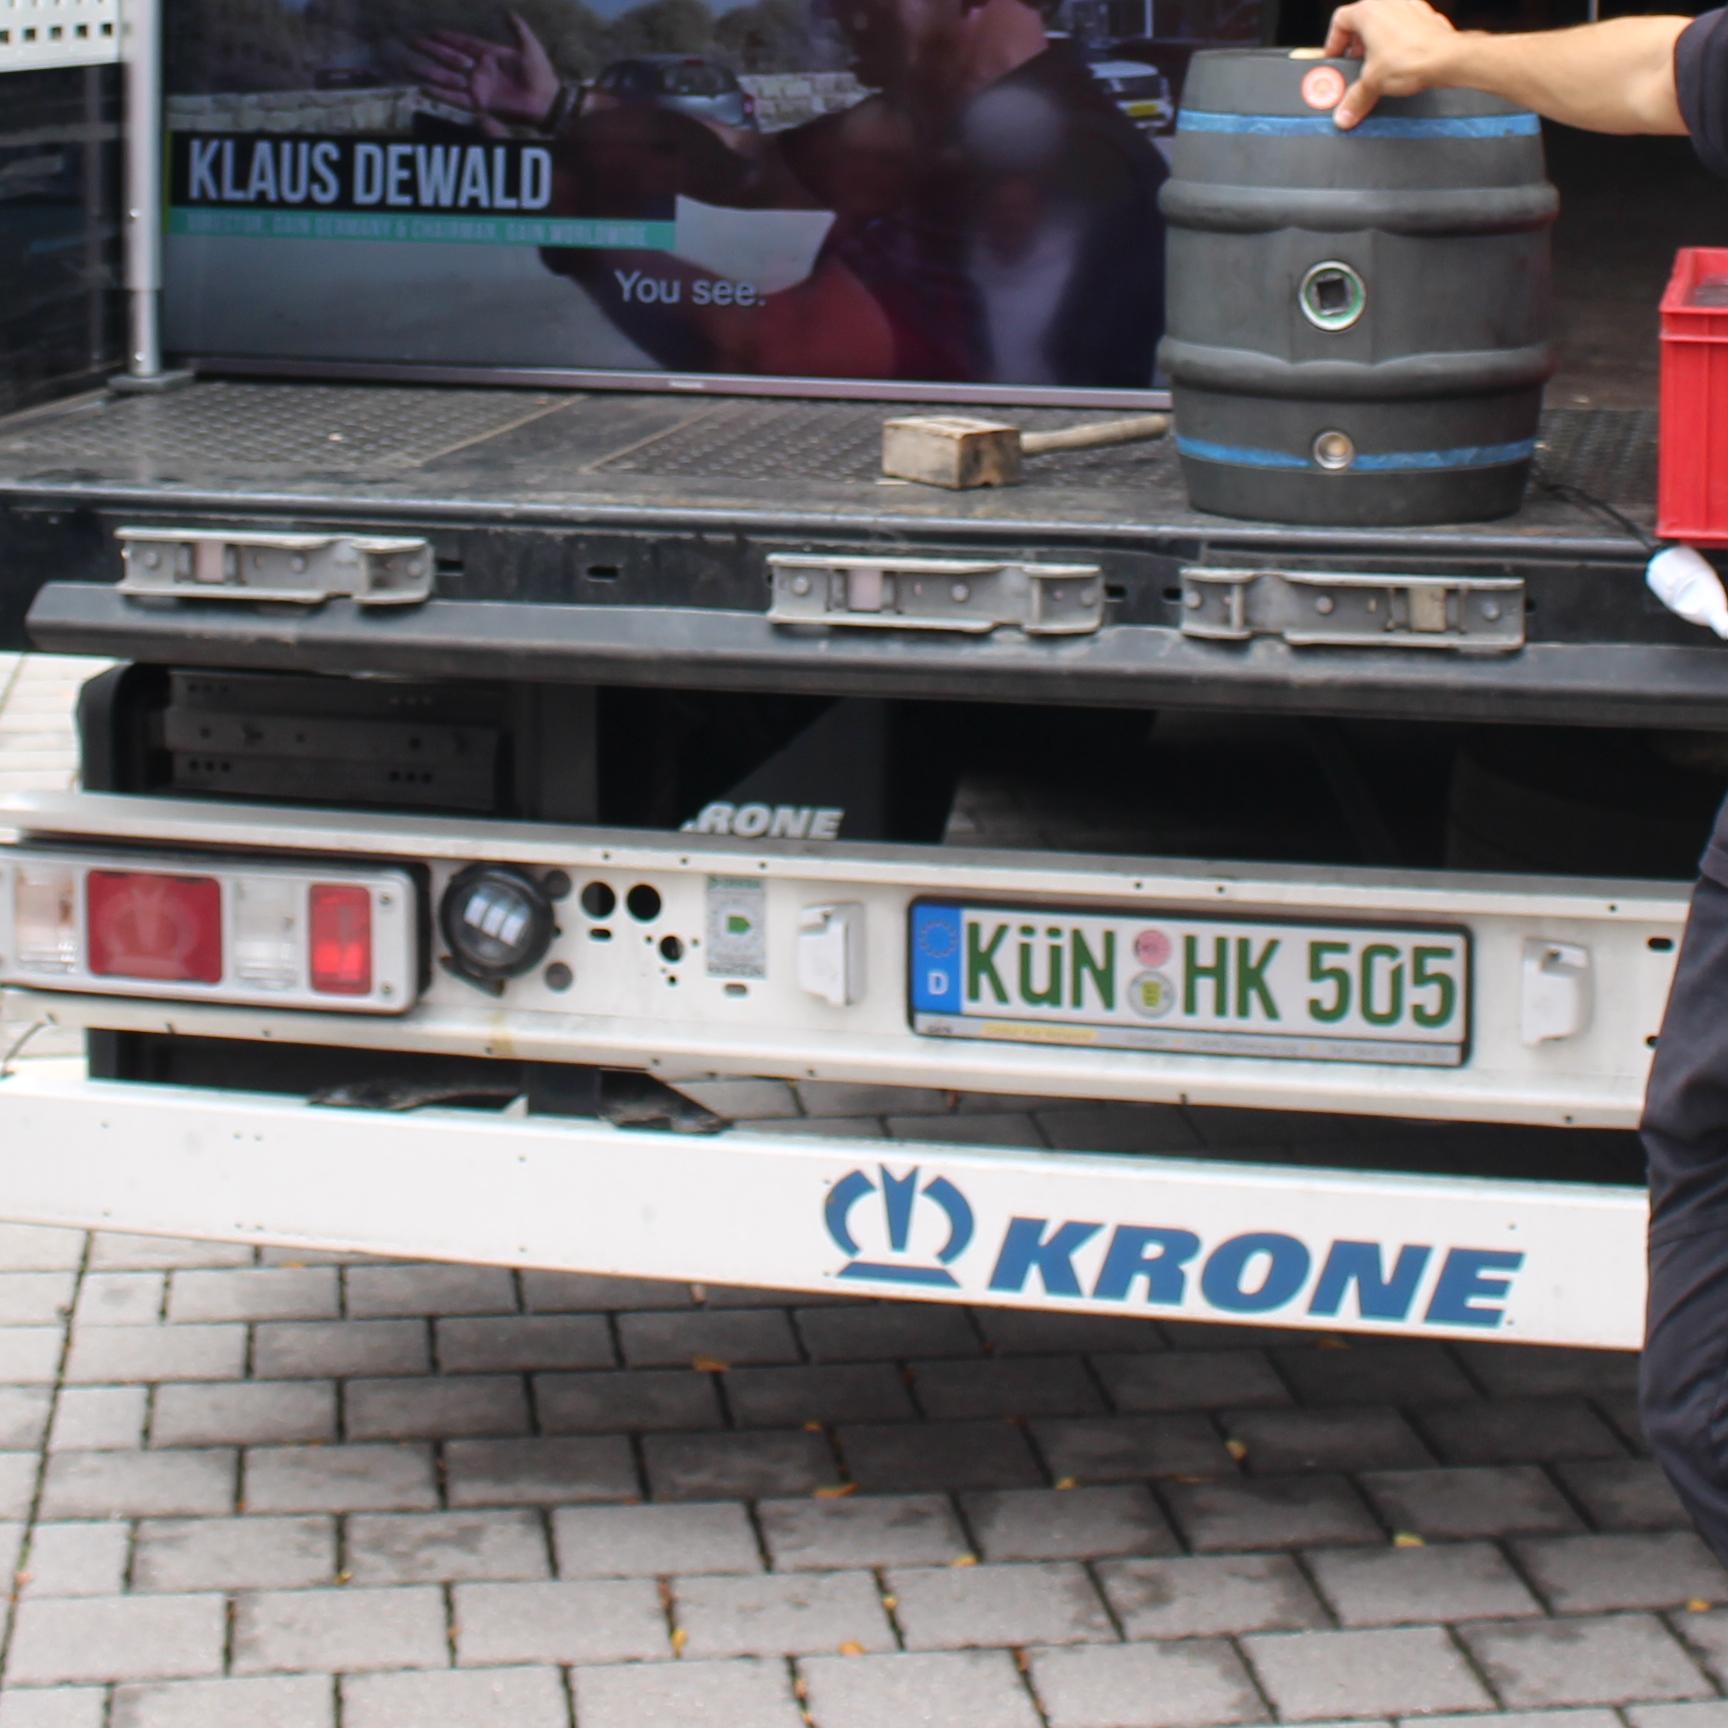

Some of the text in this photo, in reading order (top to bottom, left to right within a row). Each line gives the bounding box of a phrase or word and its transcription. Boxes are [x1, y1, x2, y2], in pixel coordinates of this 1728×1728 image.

[188, 138, 553, 211] KLAUS DEWALD
[613, 270, 767, 307] You see.
[680, 801, 845, 840] RONE
[927, 970, 950, 996] D
[1183, 934, 1281, 1021] HK
[1308, 940, 1457, 1029] 505
[987, 1216, 1525, 1329] KRONE
